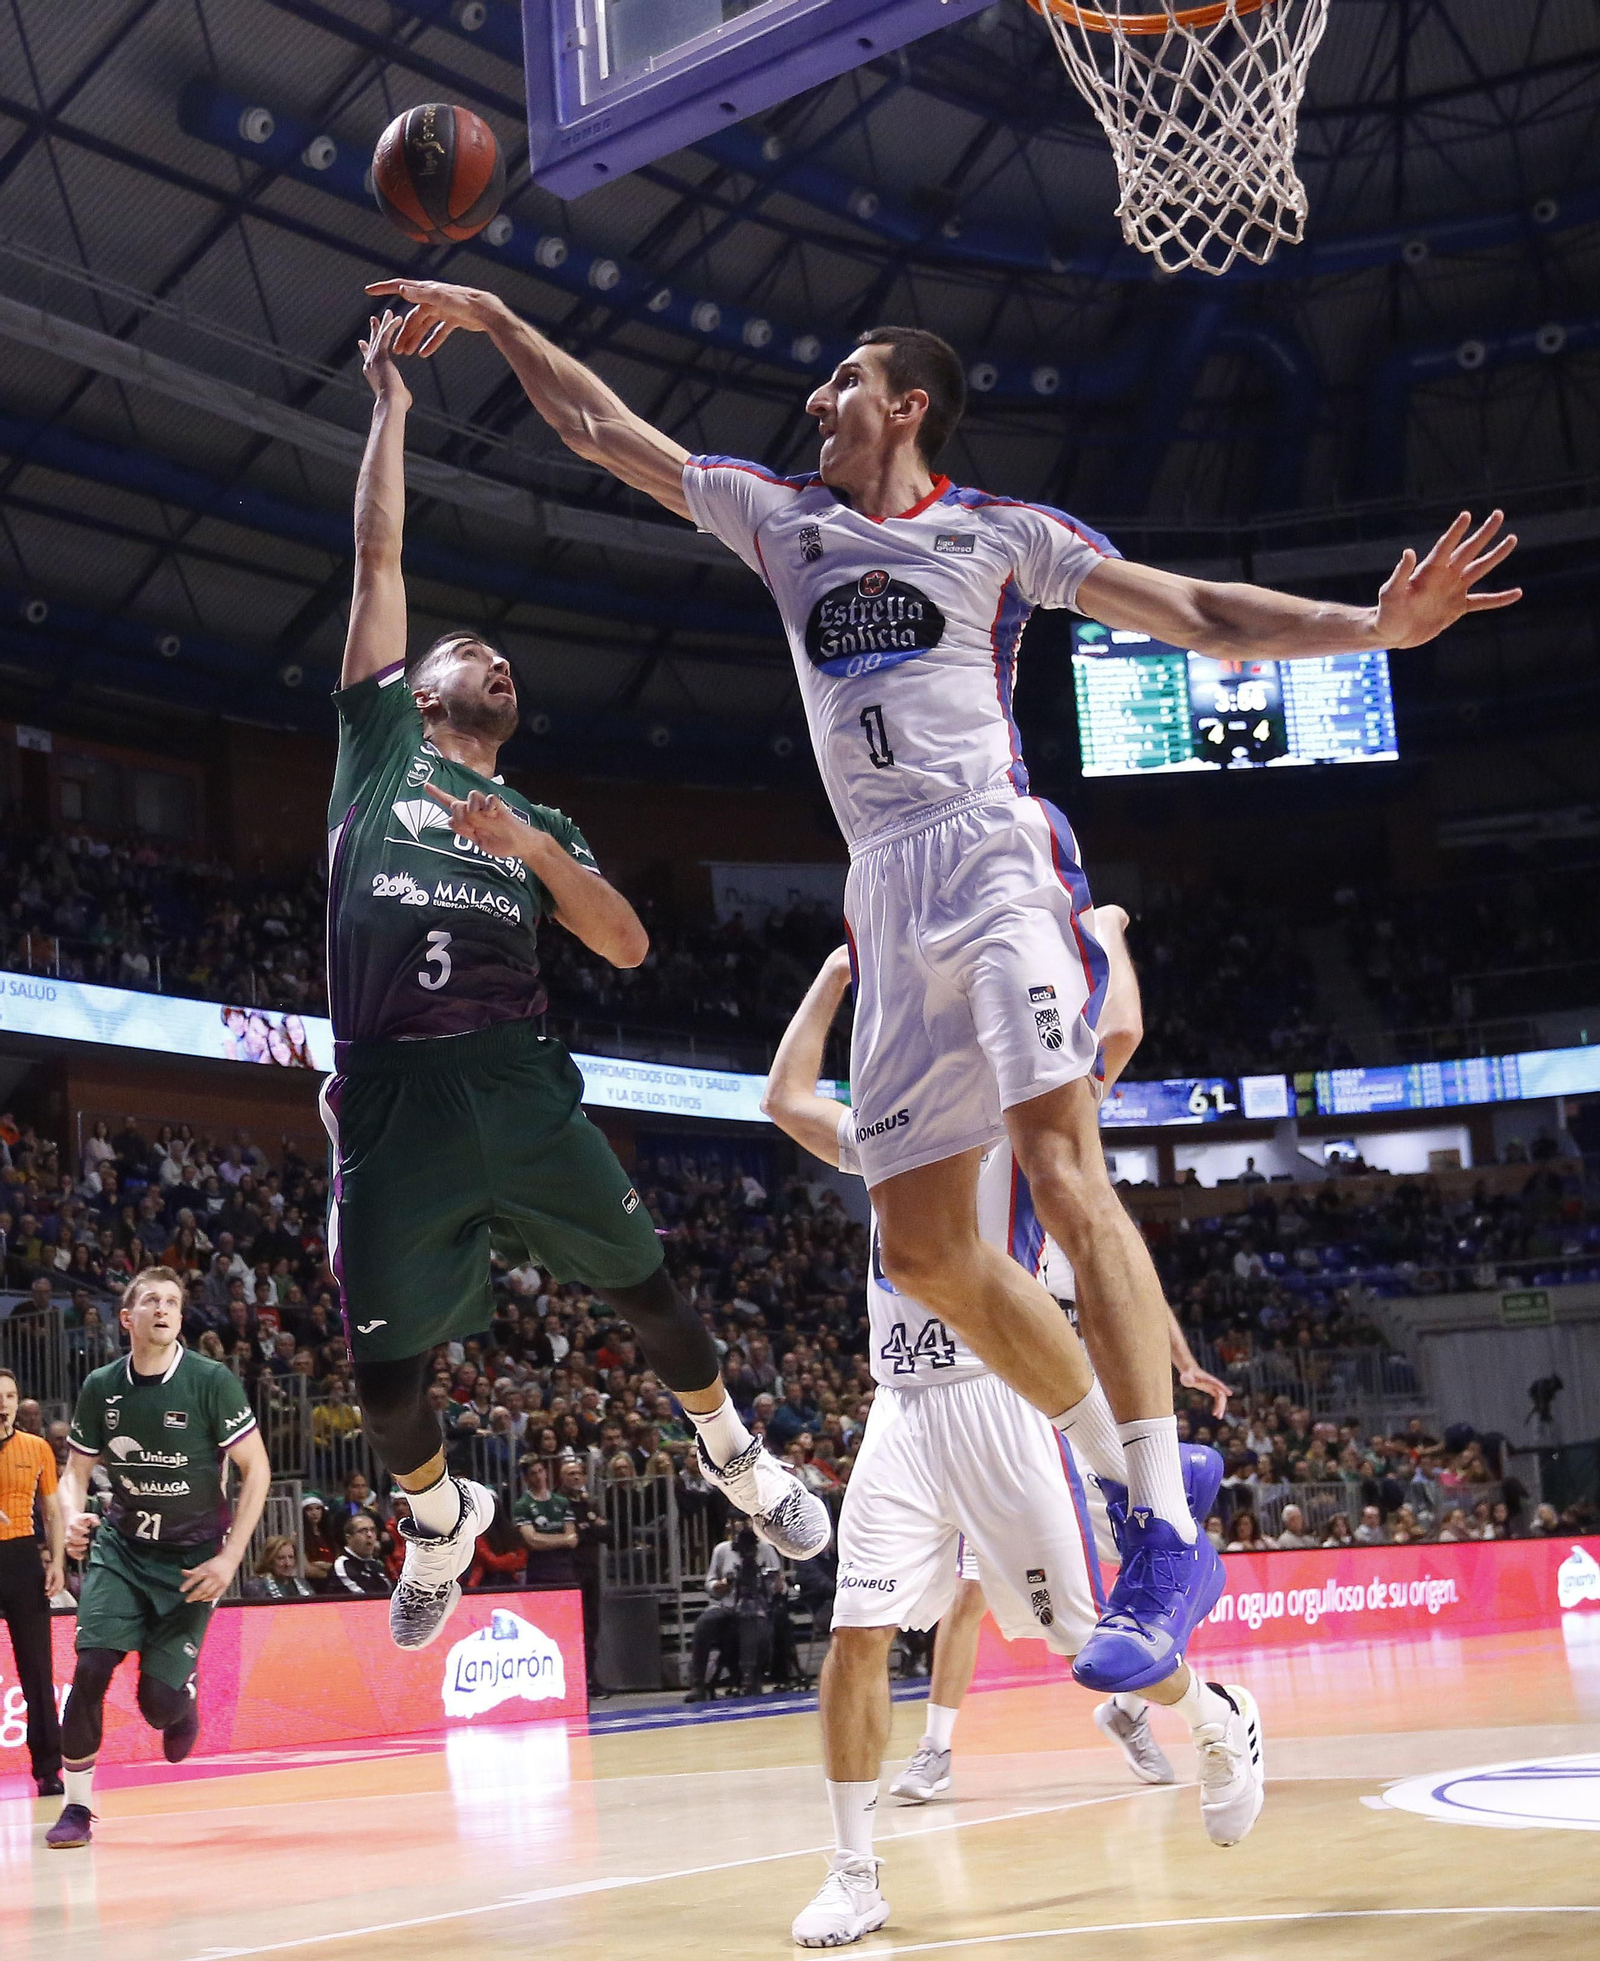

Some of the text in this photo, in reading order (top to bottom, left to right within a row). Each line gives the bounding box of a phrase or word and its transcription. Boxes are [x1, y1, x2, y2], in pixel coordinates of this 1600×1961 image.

[818, 596, 924, 628] Estrella
[820, 621, 916, 657] Galicia
[860, 705, 894, 769] 1
[453, 833, 526, 883] Uaja
[434, 880, 521, 922] MÁLAGA
[417, 929, 452, 992] 3
[10, 981, 57, 1001] SALUD
[1032, 990, 1051, 1001] acb
[606, 1087, 614, 1099] Y
[616, 1089, 629, 1102] LA
[632, 1091, 645, 1104] DE
[647, 1092, 666, 1106] LOS
[664, 1072, 686, 1087] CON
[689, 1075, 704, 1089] TU
[706, 1077, 741, 1092] SALUD
[881, 1317, 956, 1375] 44
[139, 1451, 188, 1466] Unicaja
[139, 1480, 190, 1493] MÁLAGA
[135, 1510, 162, 1541] 21
[1237, 1590, 1284, 1630] agua
[1287, 1578, 1365, 1625] orgullosa
[1366, 1576, 1387, 1611] de
[1388, 1583, 1408, 1608] su
[454, 1649, 554, 1693] Lanjarón
